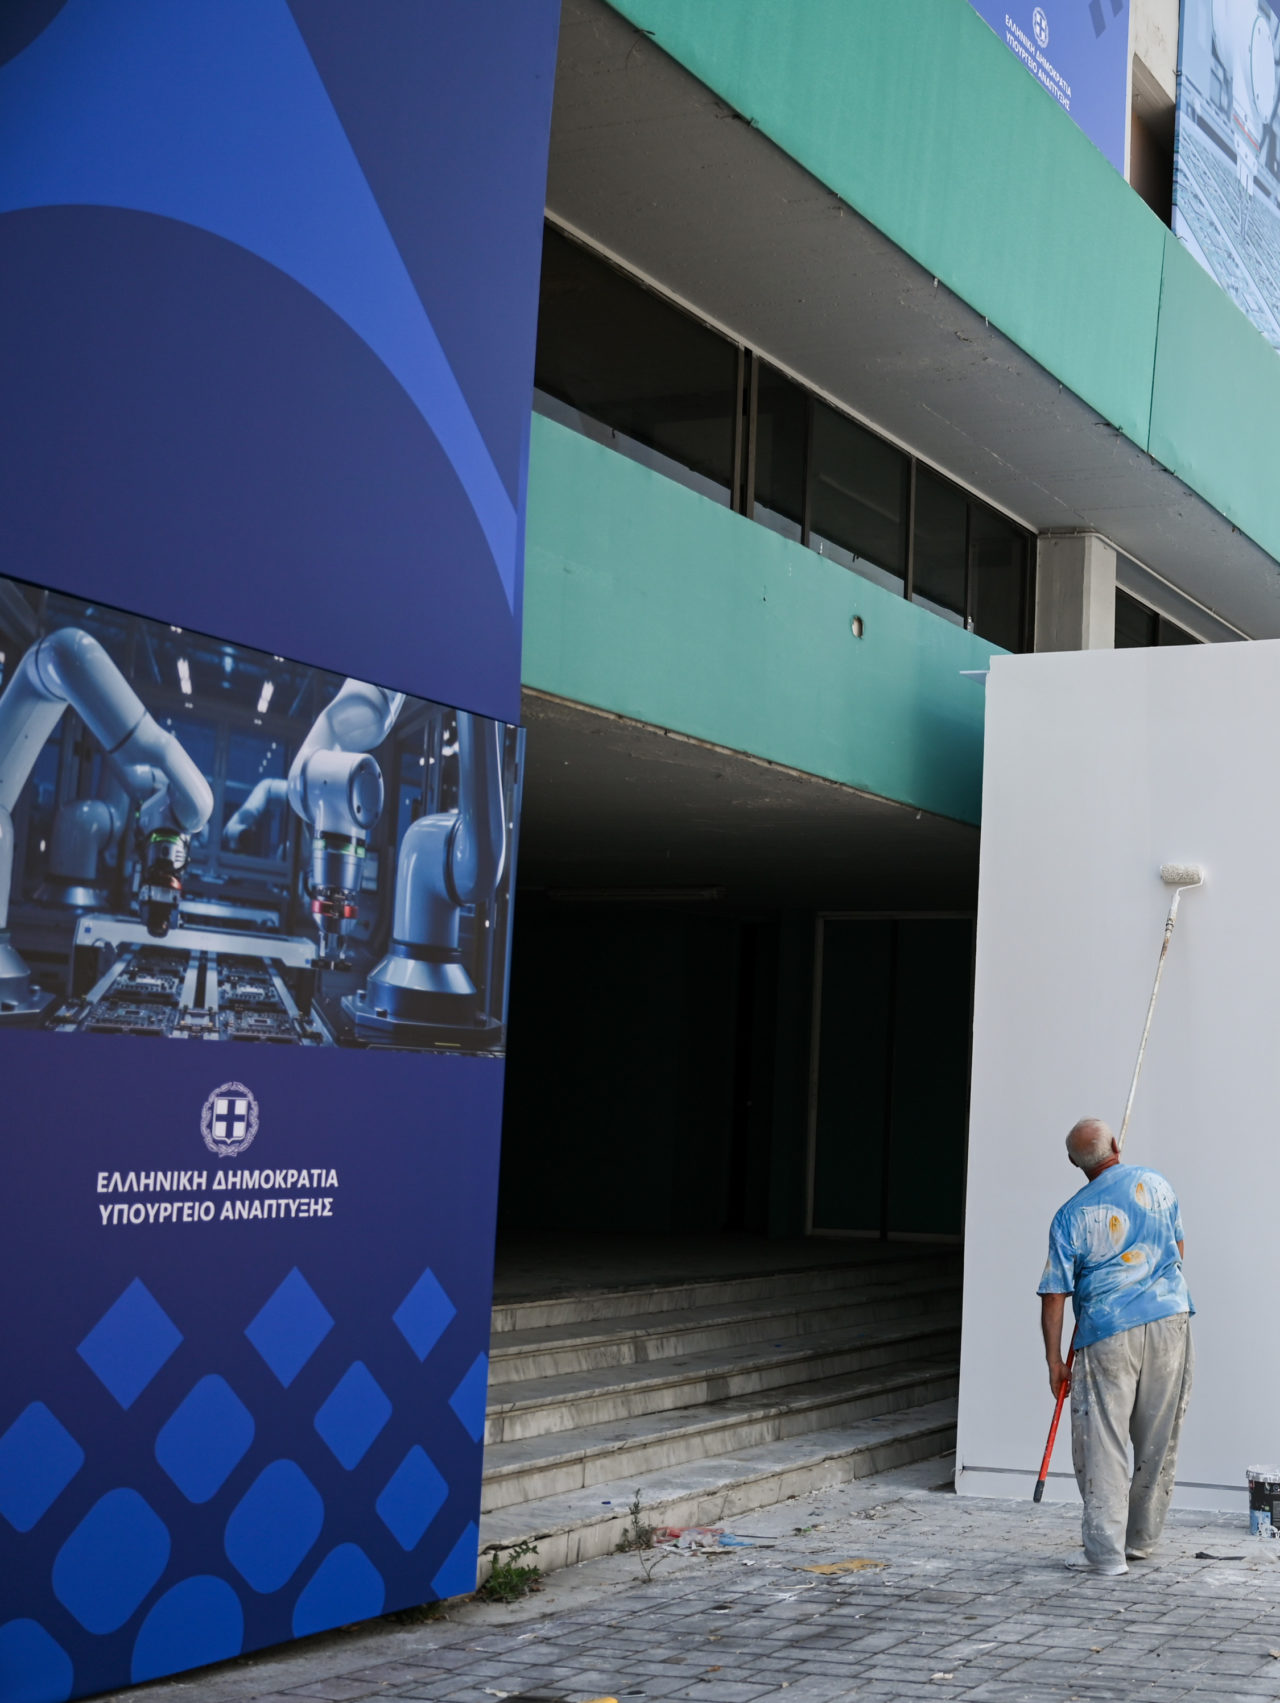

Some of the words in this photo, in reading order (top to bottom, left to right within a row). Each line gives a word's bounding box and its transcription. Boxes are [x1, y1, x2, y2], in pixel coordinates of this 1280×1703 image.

[1005, 14, 1035, 55] ΕΛΛΗΝΙΚΗ
[1036, 50, 1072, 98] ΔΗΜΟΚΡΑΤΙΑ
[1006, 30, 1037, 73] ΥΠΟΥΡΓΕΙΟ
[1038, 69, 1071, 111] ΑΝΑΠΤΥΞΗΣ
[96, 1169, 207, 1193] ΕΛΛΗΝΙΚΗ
[212, 1168, 339, 1190] ΔΗΜΟΚΡΑΤΙΑ
[98, 1201, 215, 1226] ΥΠΟΥΡΓΕΙΟ
[220, 1198, 334, 1221] ΑΝΑΠΤΥΞΗΣ
